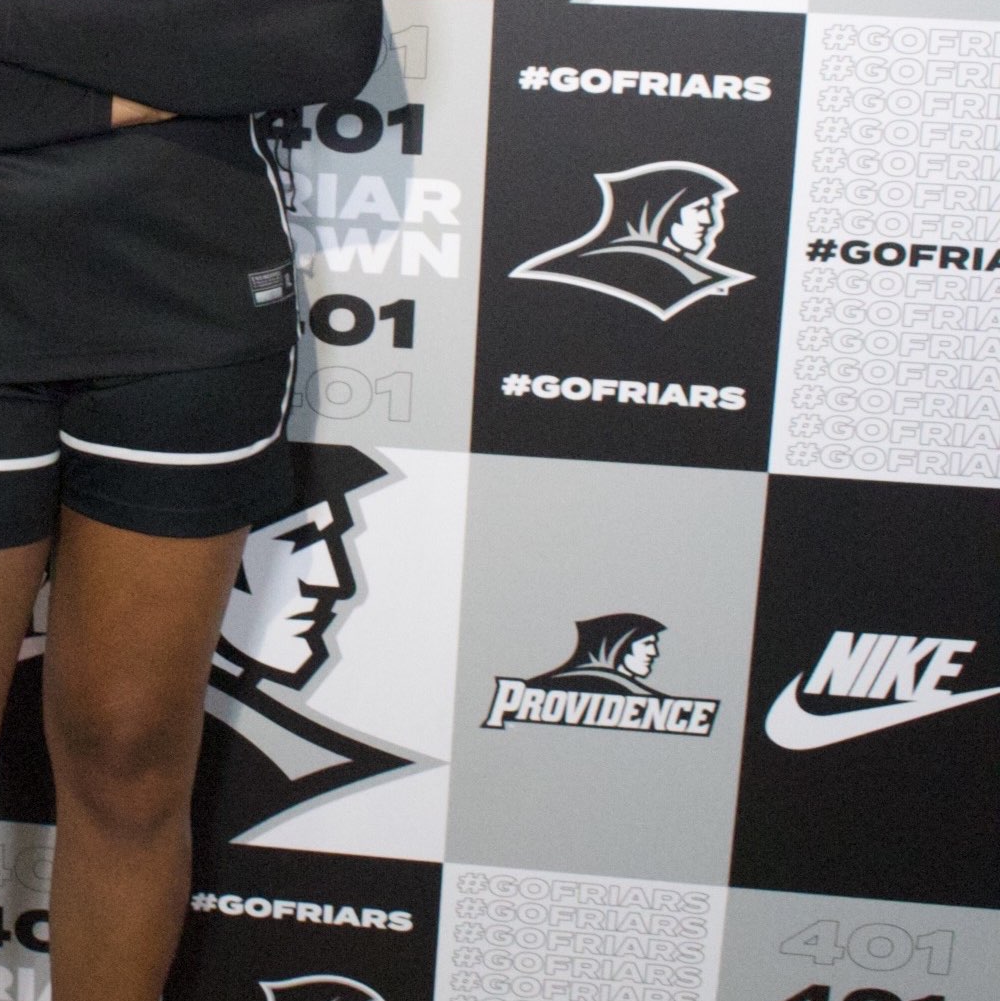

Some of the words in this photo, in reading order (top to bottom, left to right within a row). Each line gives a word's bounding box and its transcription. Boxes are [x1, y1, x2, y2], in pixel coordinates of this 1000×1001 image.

[519, 66, 772, 102] #GOFRIARS
[812, 148, 1000, 181] #GOFRI
[299, 293, 417, 349] 01
[293, 366, 413, 422] 01
[501, 374, 747, 411] #GOFRIARS
[786, 443, 1000, 478] #GOFRIA
[803, 630, 977, 701] NIKE
[481, 676, 720, 736] PROVIDENCE
[191, 892, 413, 932] #GOFRIARS
[457, 873, 710, 914] #GOFRIARS
[455, 897, 708, 939] #GOFRIARS
[453, 922, 705, 964] #GOFRIARS
[779, 919, 954, 976] 401
[452, 946, 702, 989] #GOFRIARS
